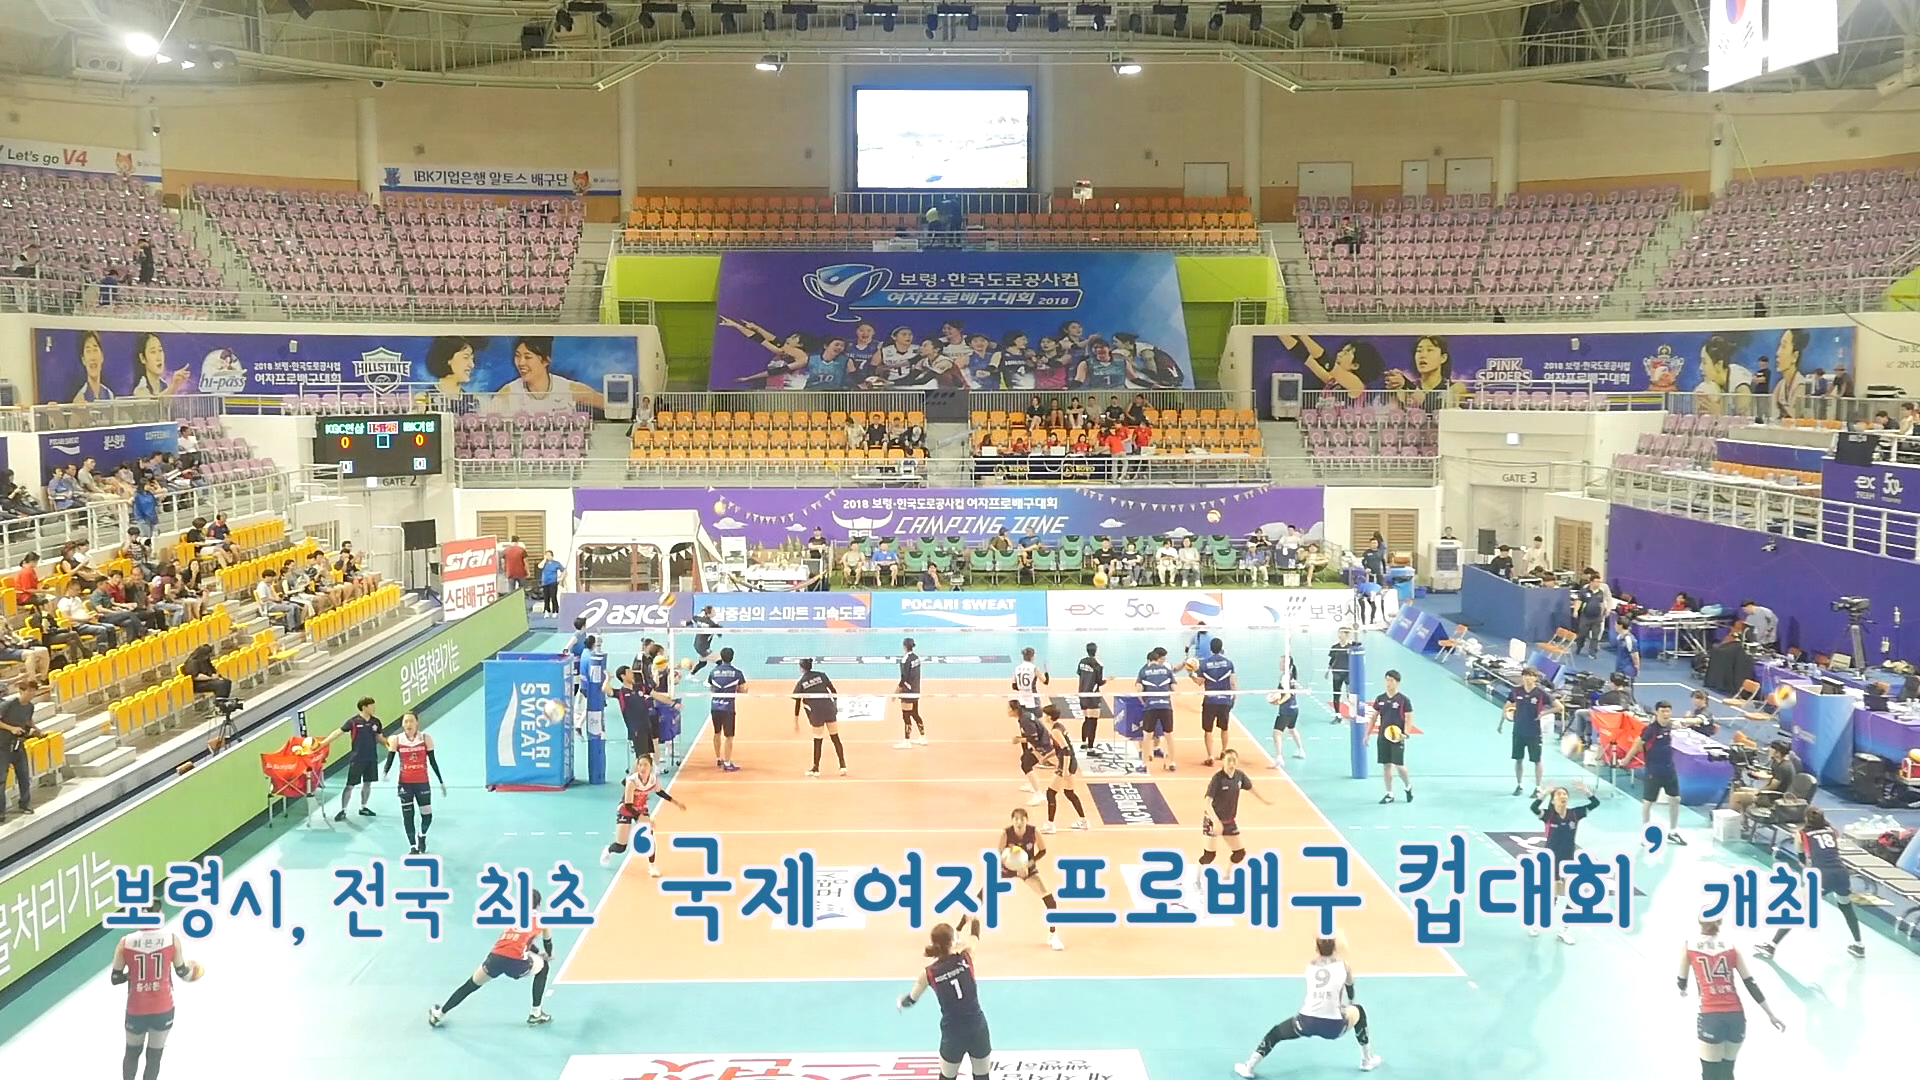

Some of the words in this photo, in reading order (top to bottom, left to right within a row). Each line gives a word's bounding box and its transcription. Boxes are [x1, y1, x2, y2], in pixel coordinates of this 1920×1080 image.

[7, 148, 39, 163] Let's
[42, 153, 60, 166] go
[62, 148, 88, 167] V4
[413, 170, 486, 186] IBK기업은행
[489, 171, 528, 186] 알토스
[531, 172, 568, 188] 배구단
[887, 290, 1034, 305] 여자프로배구대회
[1038, 296, 1069, 305] 2018
[254, 362, 268, 371] 2018
[353, 361, 412, 378] HILLSTATE
[1487, 358, 1522, 371] PINK
[1543, 361, 1564, 371] 2018
[254, 373, 342, 386] 여자프로배구대회
[1476, 370, 1532, 382] SPIDERS
[340, 436, 350, 449] 0
[415, 434, 425, 447] 0
[382, 477, 406, 487] GATE
[409, 474, 417, 487] 2
[1502, 473, 1527, 483] GATE
[1530, 471, 1538, 484] 3
[843, 499, 869, 510] 2018
[966, 497, 1058, 510] 여자프로배구대회
[893, 515, 1007, 536] CAMPING
[1010, 515, 1070, 535] ZONE
[444, 581, 496, 613] 스타배구공
[901, 598, 960, 611] POCARI
[961, 598, 1017, 611] SWEAT
[768, 605, 810, 622] 스마트
[812, 605, 867, 622] 고속도로
[400, 638, 460, 706] 음식물처리기는
[1016, 672, 1031, 687] 16
[520, 682, 537, 761] SWEAT
[535, 683, 551, 768] POCARI
[1812, 833, 1836, 849] 18
[134, 952, 163, 981] 11
[1696, 955, 1732, 984] 14
[1314, 968, 1331, 989] 9
[950, 978, 963, 1000] 1
